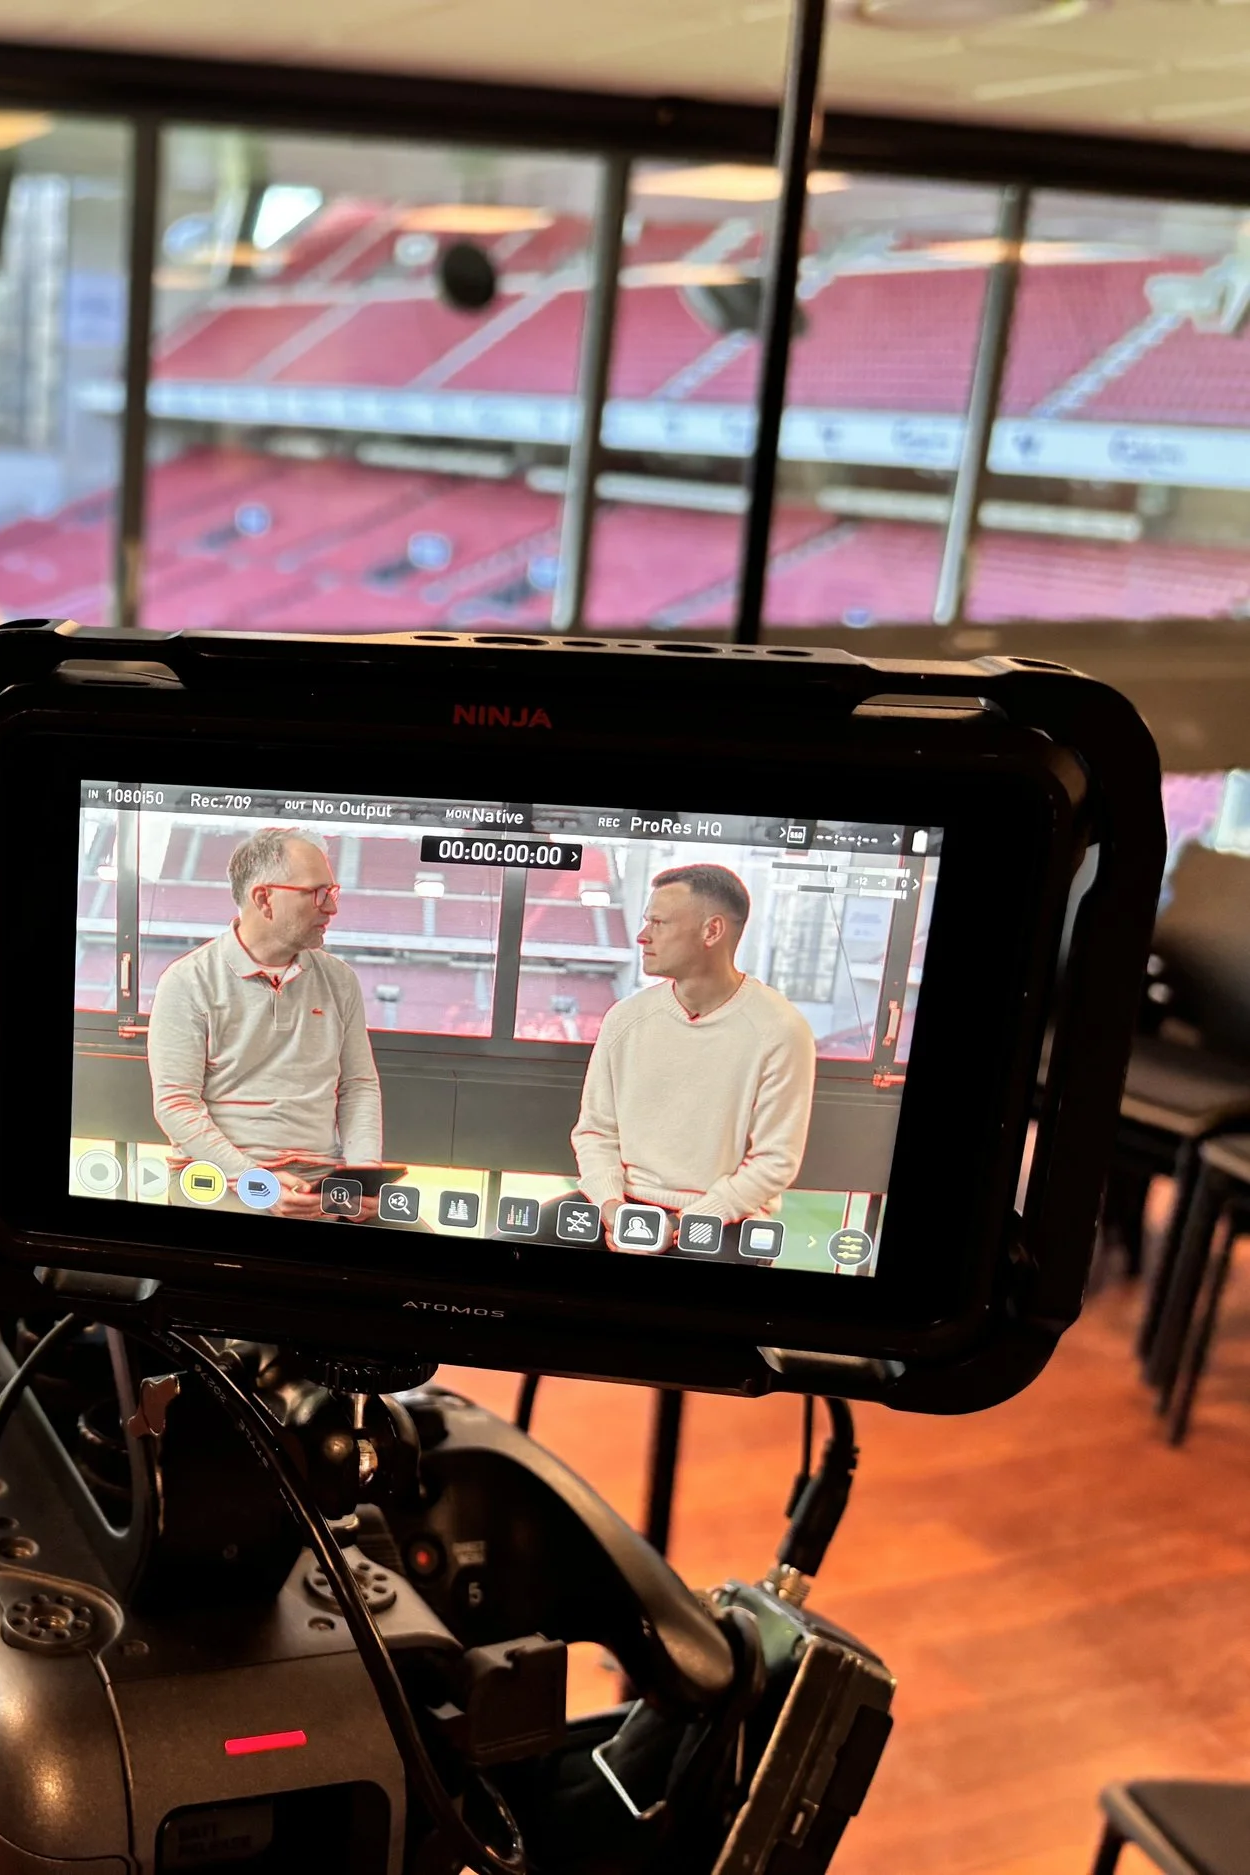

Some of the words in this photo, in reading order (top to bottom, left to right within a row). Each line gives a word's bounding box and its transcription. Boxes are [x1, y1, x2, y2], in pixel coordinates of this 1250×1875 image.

[453, 704, 552, 729] NINJA
[88, 789, 99, 799] IN
[106, 788, 164, 805] 1080i50
[190, 793, 252, 810] Rec.709
[284, 801, 306, 811] OUT
[312, 800, 334, 814] No
[339, 801, 392, 820] Output
[445, 808, 470, 820] MON
[471, 807, 525, 825] Native
[597, 817, 620, 828] REC
[630, 816, 692, 835] ProRes
[696, 820, 723, 837] HQ
[438, 839, 562, 865] 00:00:00:00
[331, 1189, 348, 1202] 1:1
[402, 1300, 505, 1318] ATOMOS
